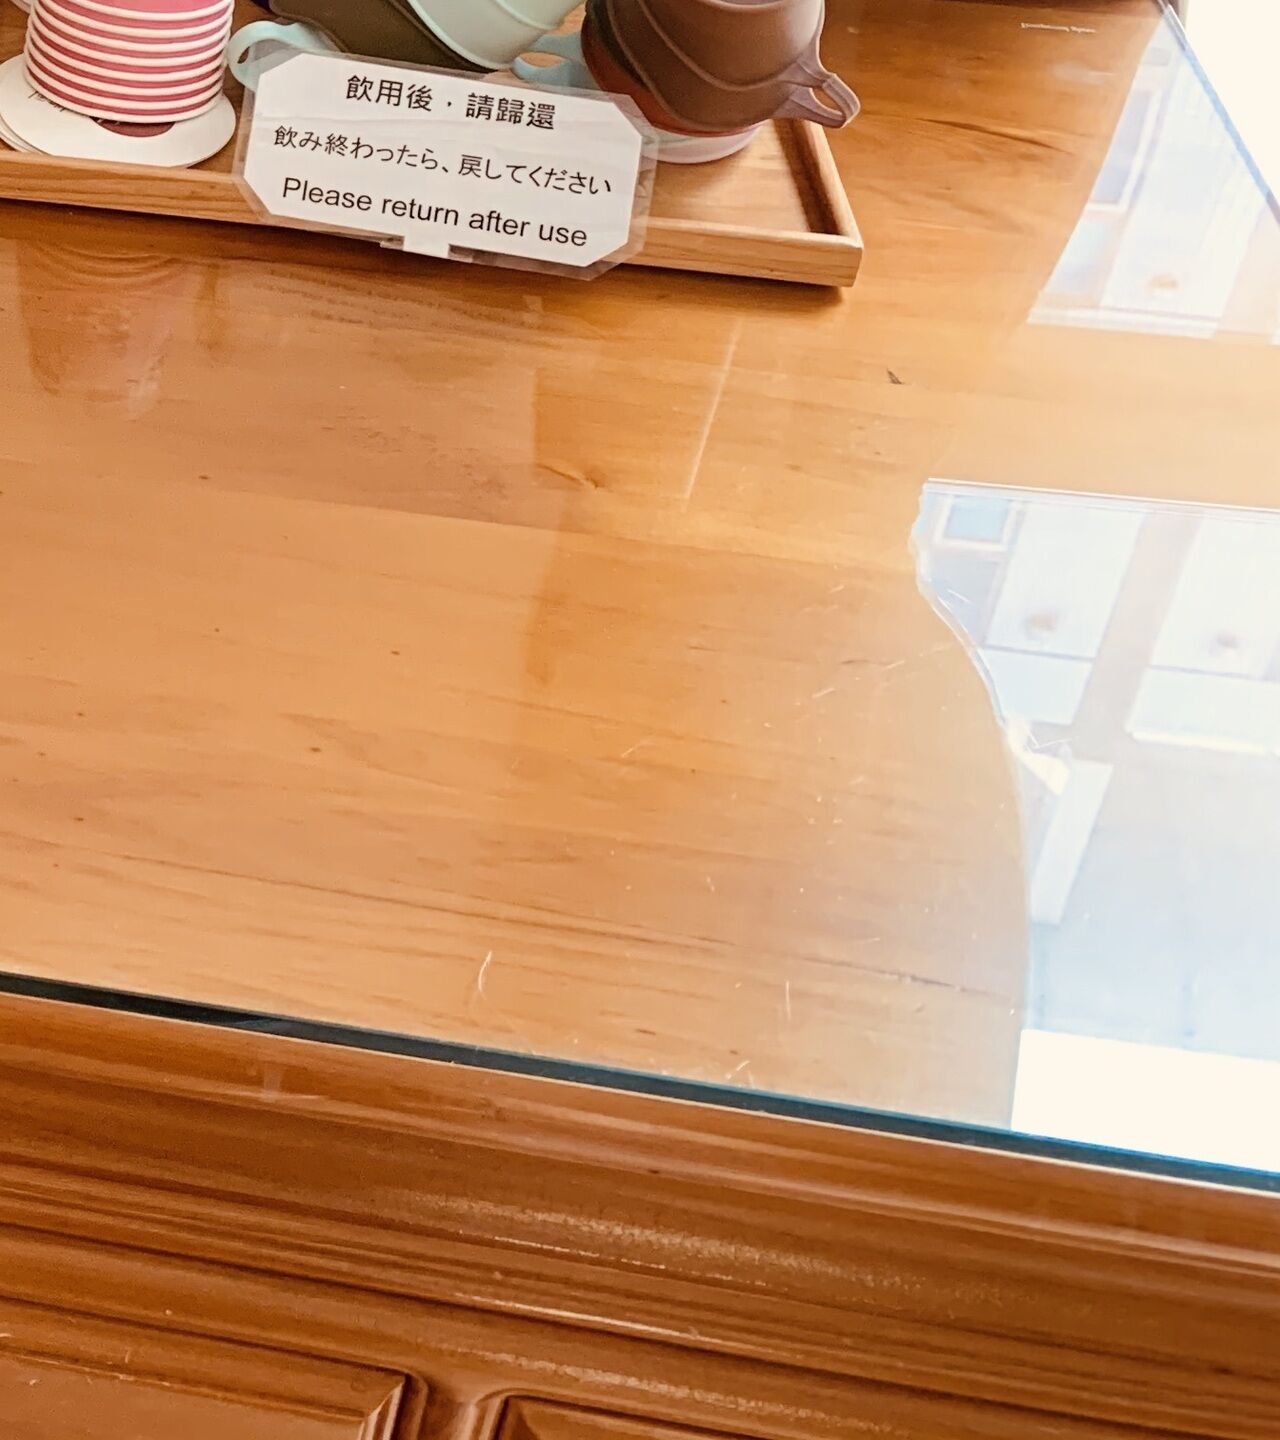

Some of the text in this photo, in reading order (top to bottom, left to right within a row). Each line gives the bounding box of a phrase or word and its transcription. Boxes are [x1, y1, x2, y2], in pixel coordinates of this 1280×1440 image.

[272, 125, 612, 196] 飲み終わったら、戻してください
[282, 176, 588, 247] Please return after use
